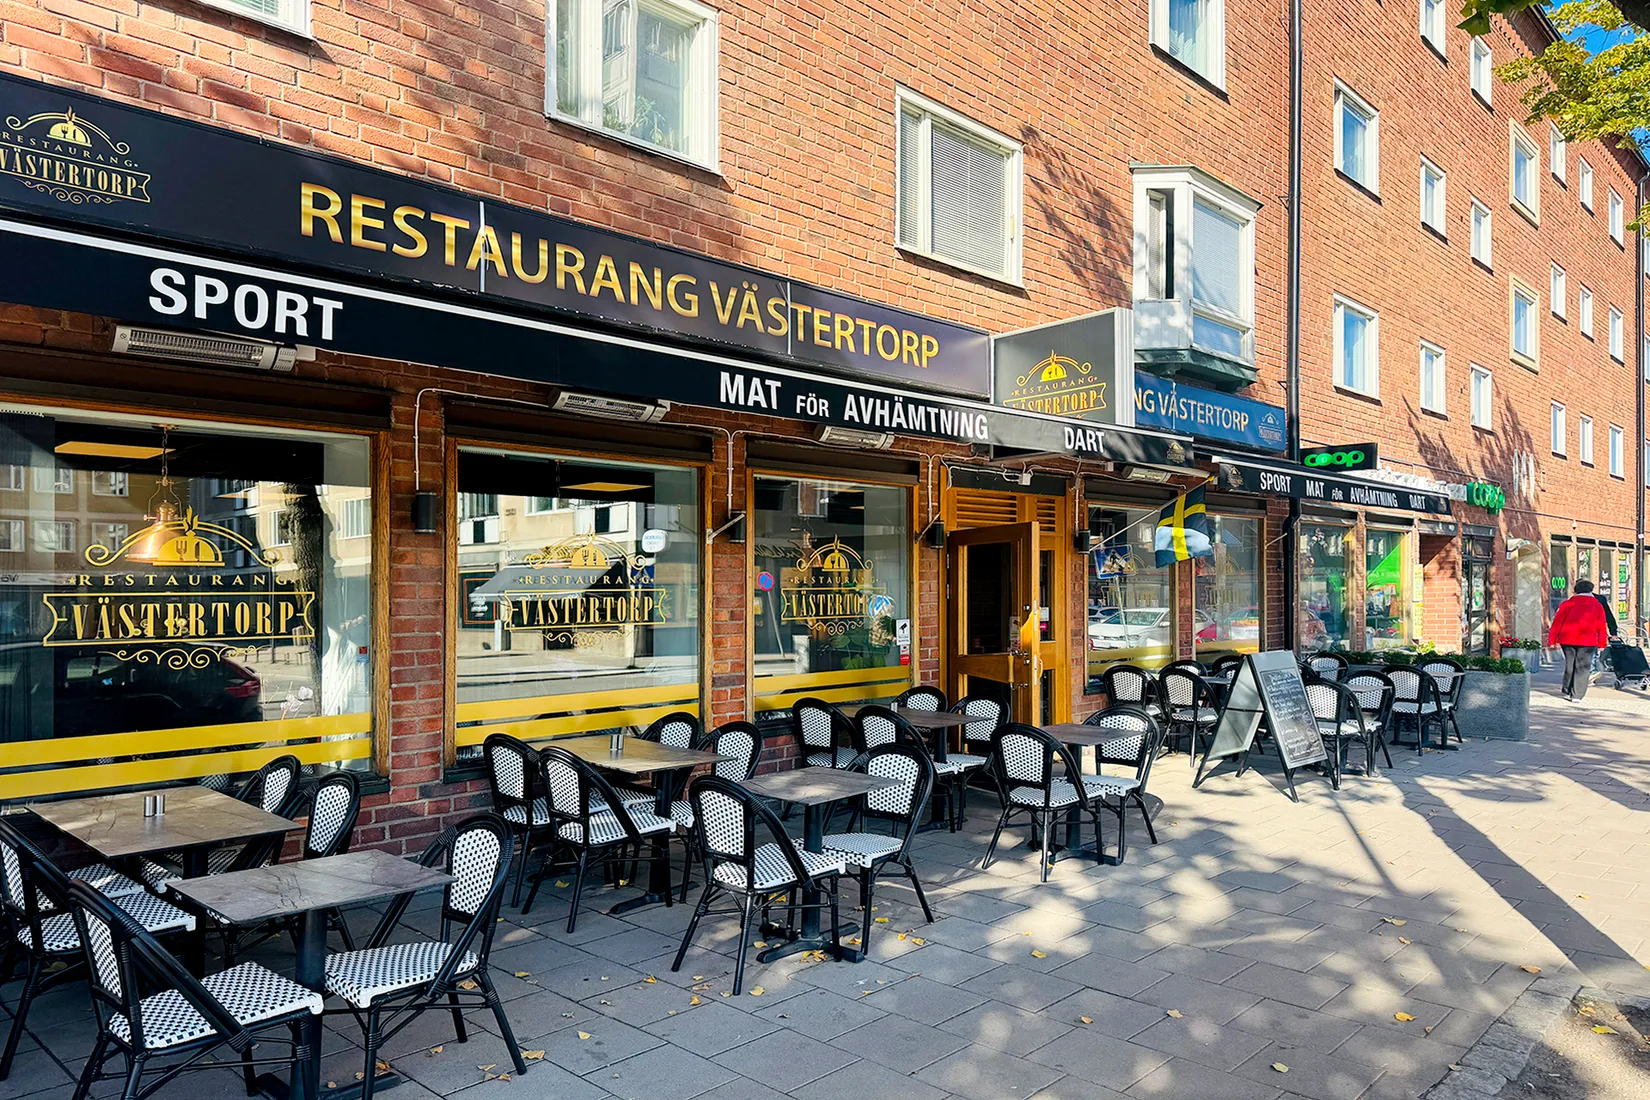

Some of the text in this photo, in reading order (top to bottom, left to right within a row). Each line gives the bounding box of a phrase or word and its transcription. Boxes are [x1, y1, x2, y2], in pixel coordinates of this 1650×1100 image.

[2, 131, 133, 168] RESTAURANG
[300, 182, 940, 369] RESTAURANG VÄSTERTORP
[148, 267, 1105, 453] SPORT MAT FÖR AVHÄMTNING DART
[1014, 376, 1094, 396] RESTAURANG
[1158, 389, 1249, 432] VÄSTERTORP
[1304, 450, 1365, 468] coop
[1260, 471, 1292, 493] SPORT
[1306, 480, 1325, 498] MAT
[1350, 485, 1399, 508] AVHÄMTNING
[1410, 494, 1426, 509] DART
[79, 574, 287, 587] RESTAURANG
[525, 575, 650, 585] RESTAURANG
[71, 597, 296, 640] VÄSTERTORP
[521, 594, 654, 626] VÄSTERTORP
